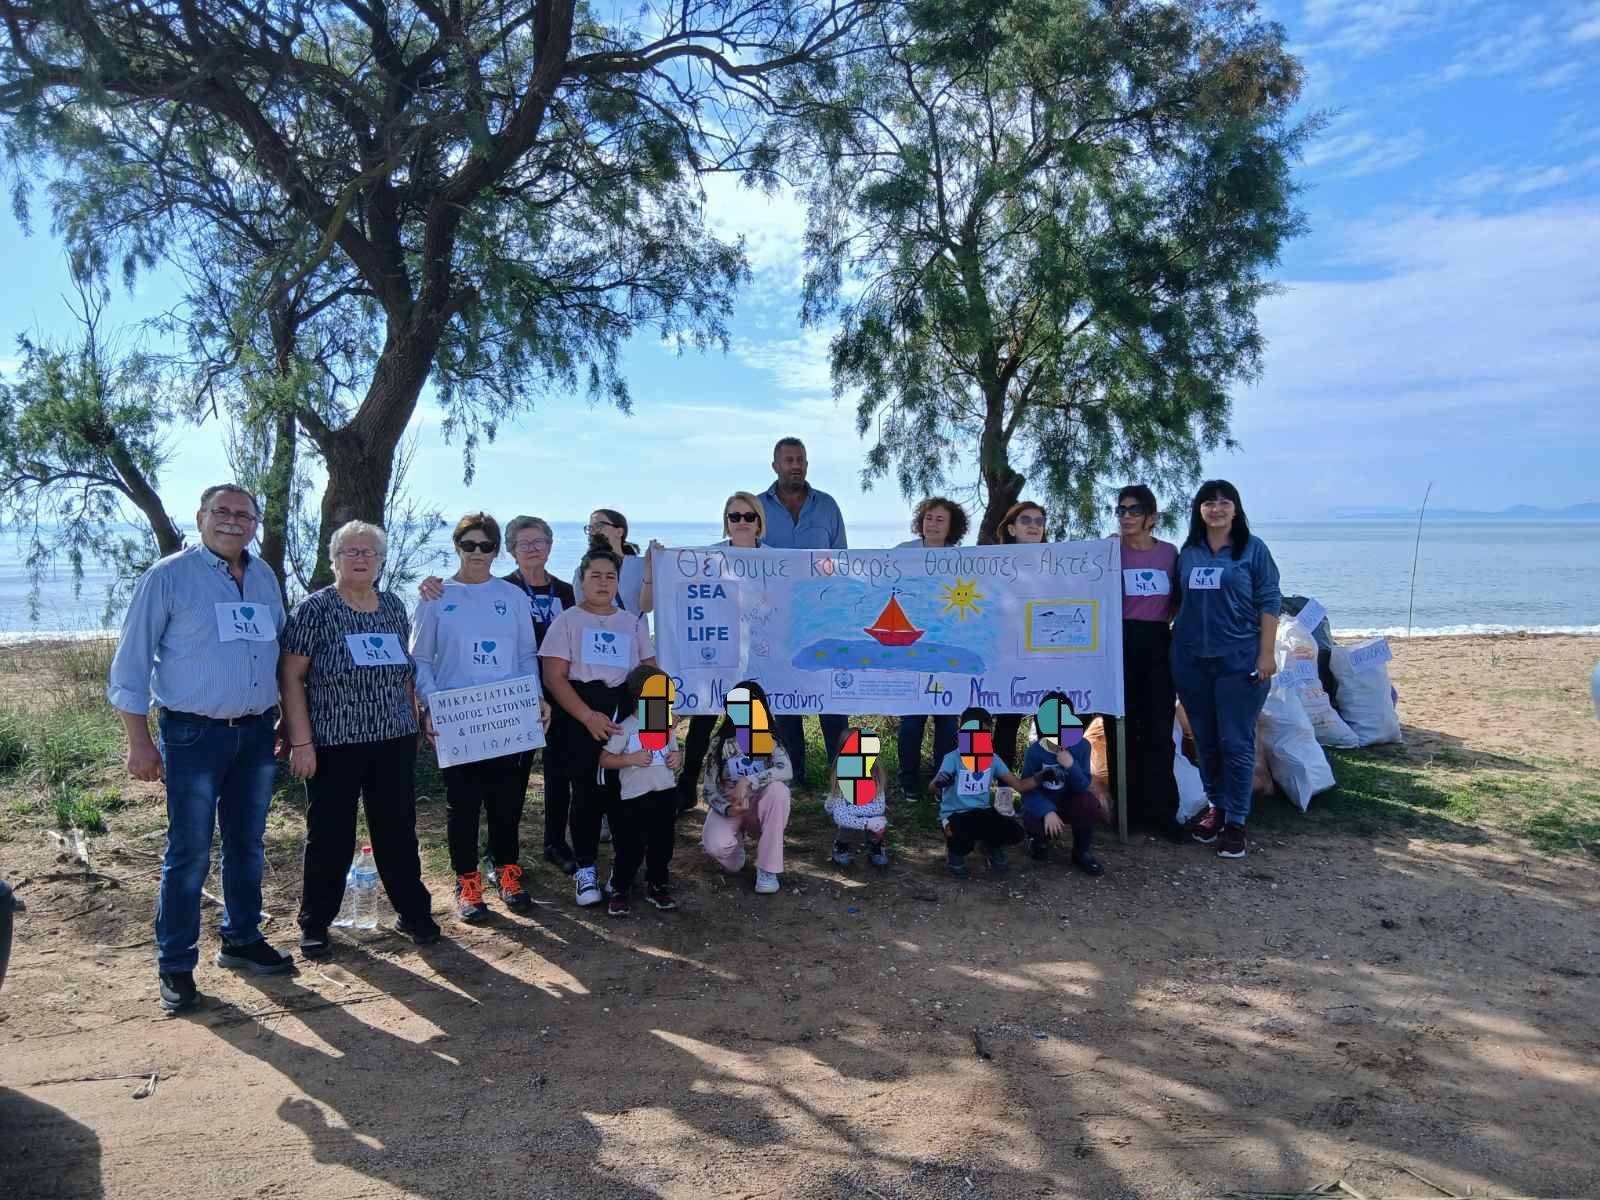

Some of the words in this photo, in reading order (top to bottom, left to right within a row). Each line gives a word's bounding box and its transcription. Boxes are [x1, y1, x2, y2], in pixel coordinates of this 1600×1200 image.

[687, 584, 727, 599] SEA
[687, 606, 704, 620] IS
[233, 622, 260, 634] SEA
[687, 626, 729, 641] LIFE
[366, 649, 392, 660] SEA
[593, 643, 617, 655] SEA
[472, 654, 499, 665] SEA
[438, 683, 531, 709] ΜΙΚΡΑΣΙΑΤΙΚΟΣ
[435, 708, 483, 725] ΣΥΛΛΟΓΟΣ
[486, 697, 537, 716] ΓΑΣΤΟΥΝΗΣ
[458, 728, 466, 737] &
[469, 717, 521, 735] ΠΕΡΙΧΩΡΩΝ
